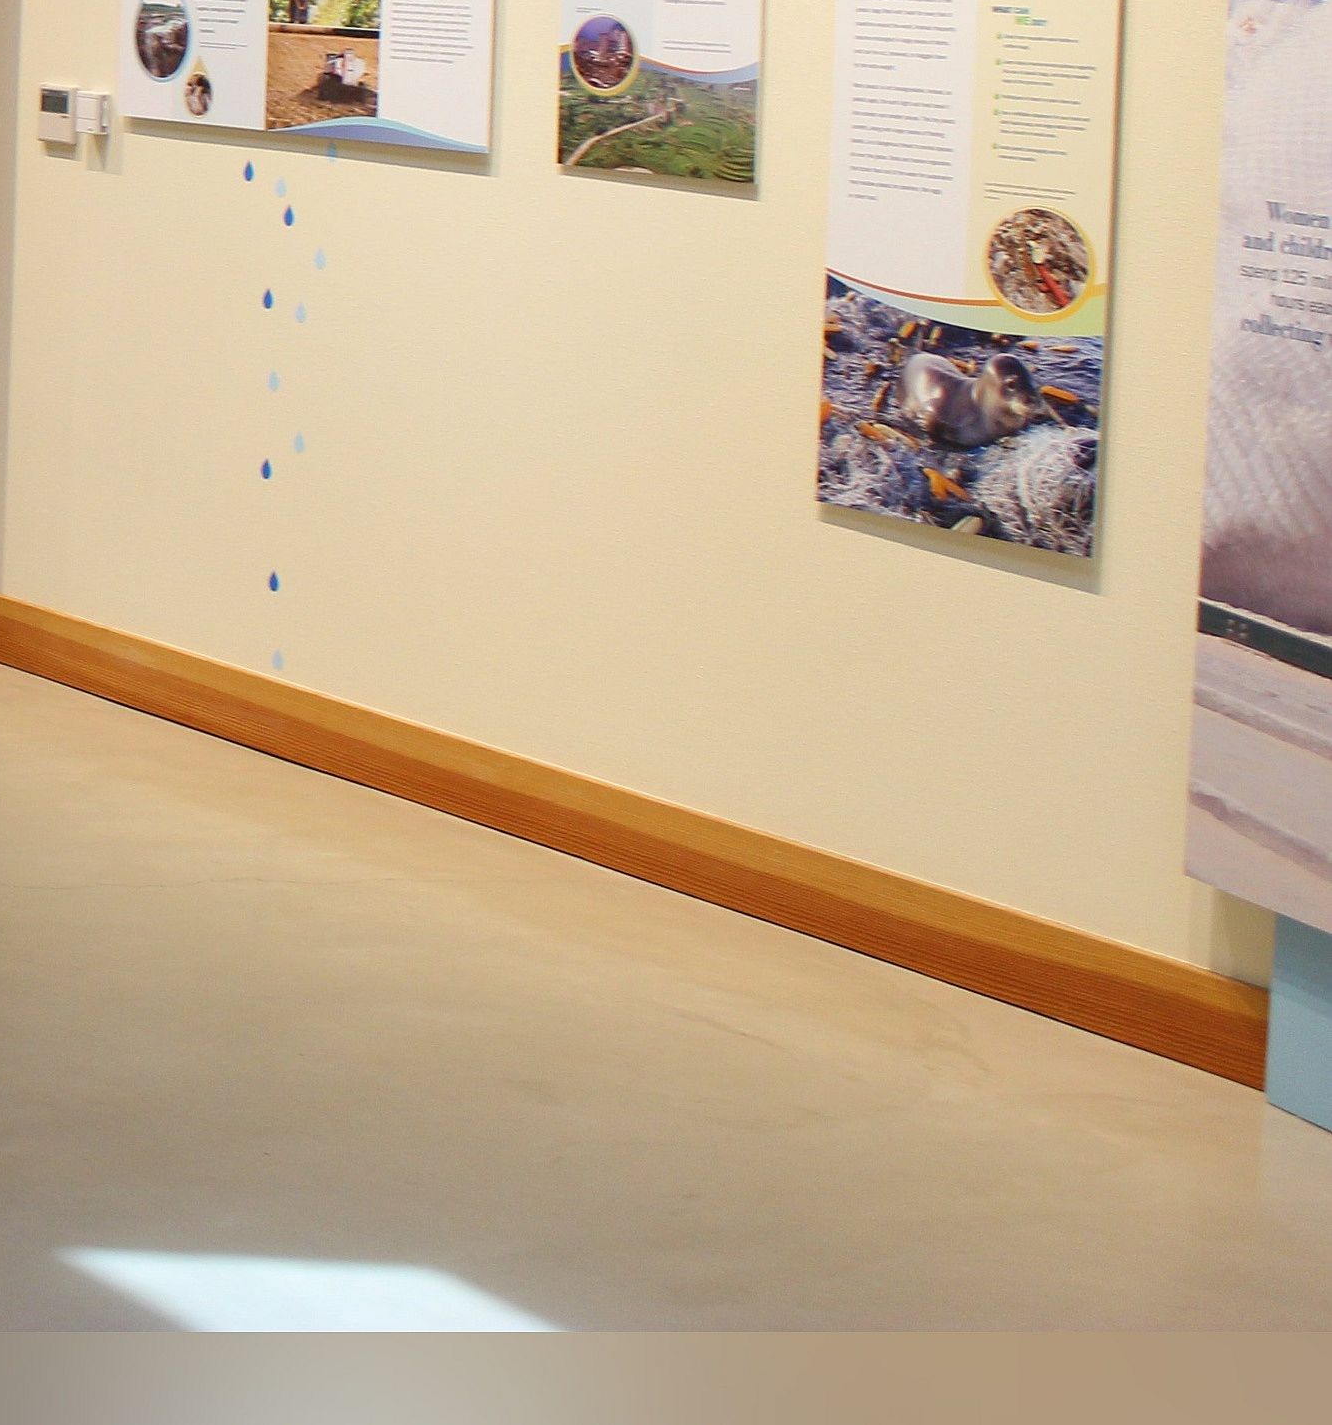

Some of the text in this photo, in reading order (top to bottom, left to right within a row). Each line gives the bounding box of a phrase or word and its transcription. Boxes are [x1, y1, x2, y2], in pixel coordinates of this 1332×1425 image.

[1266, 200, 1331, 229] Women
[1242, 231, 1275, 253] and
[1240, 314, 1324, 352] collecting
